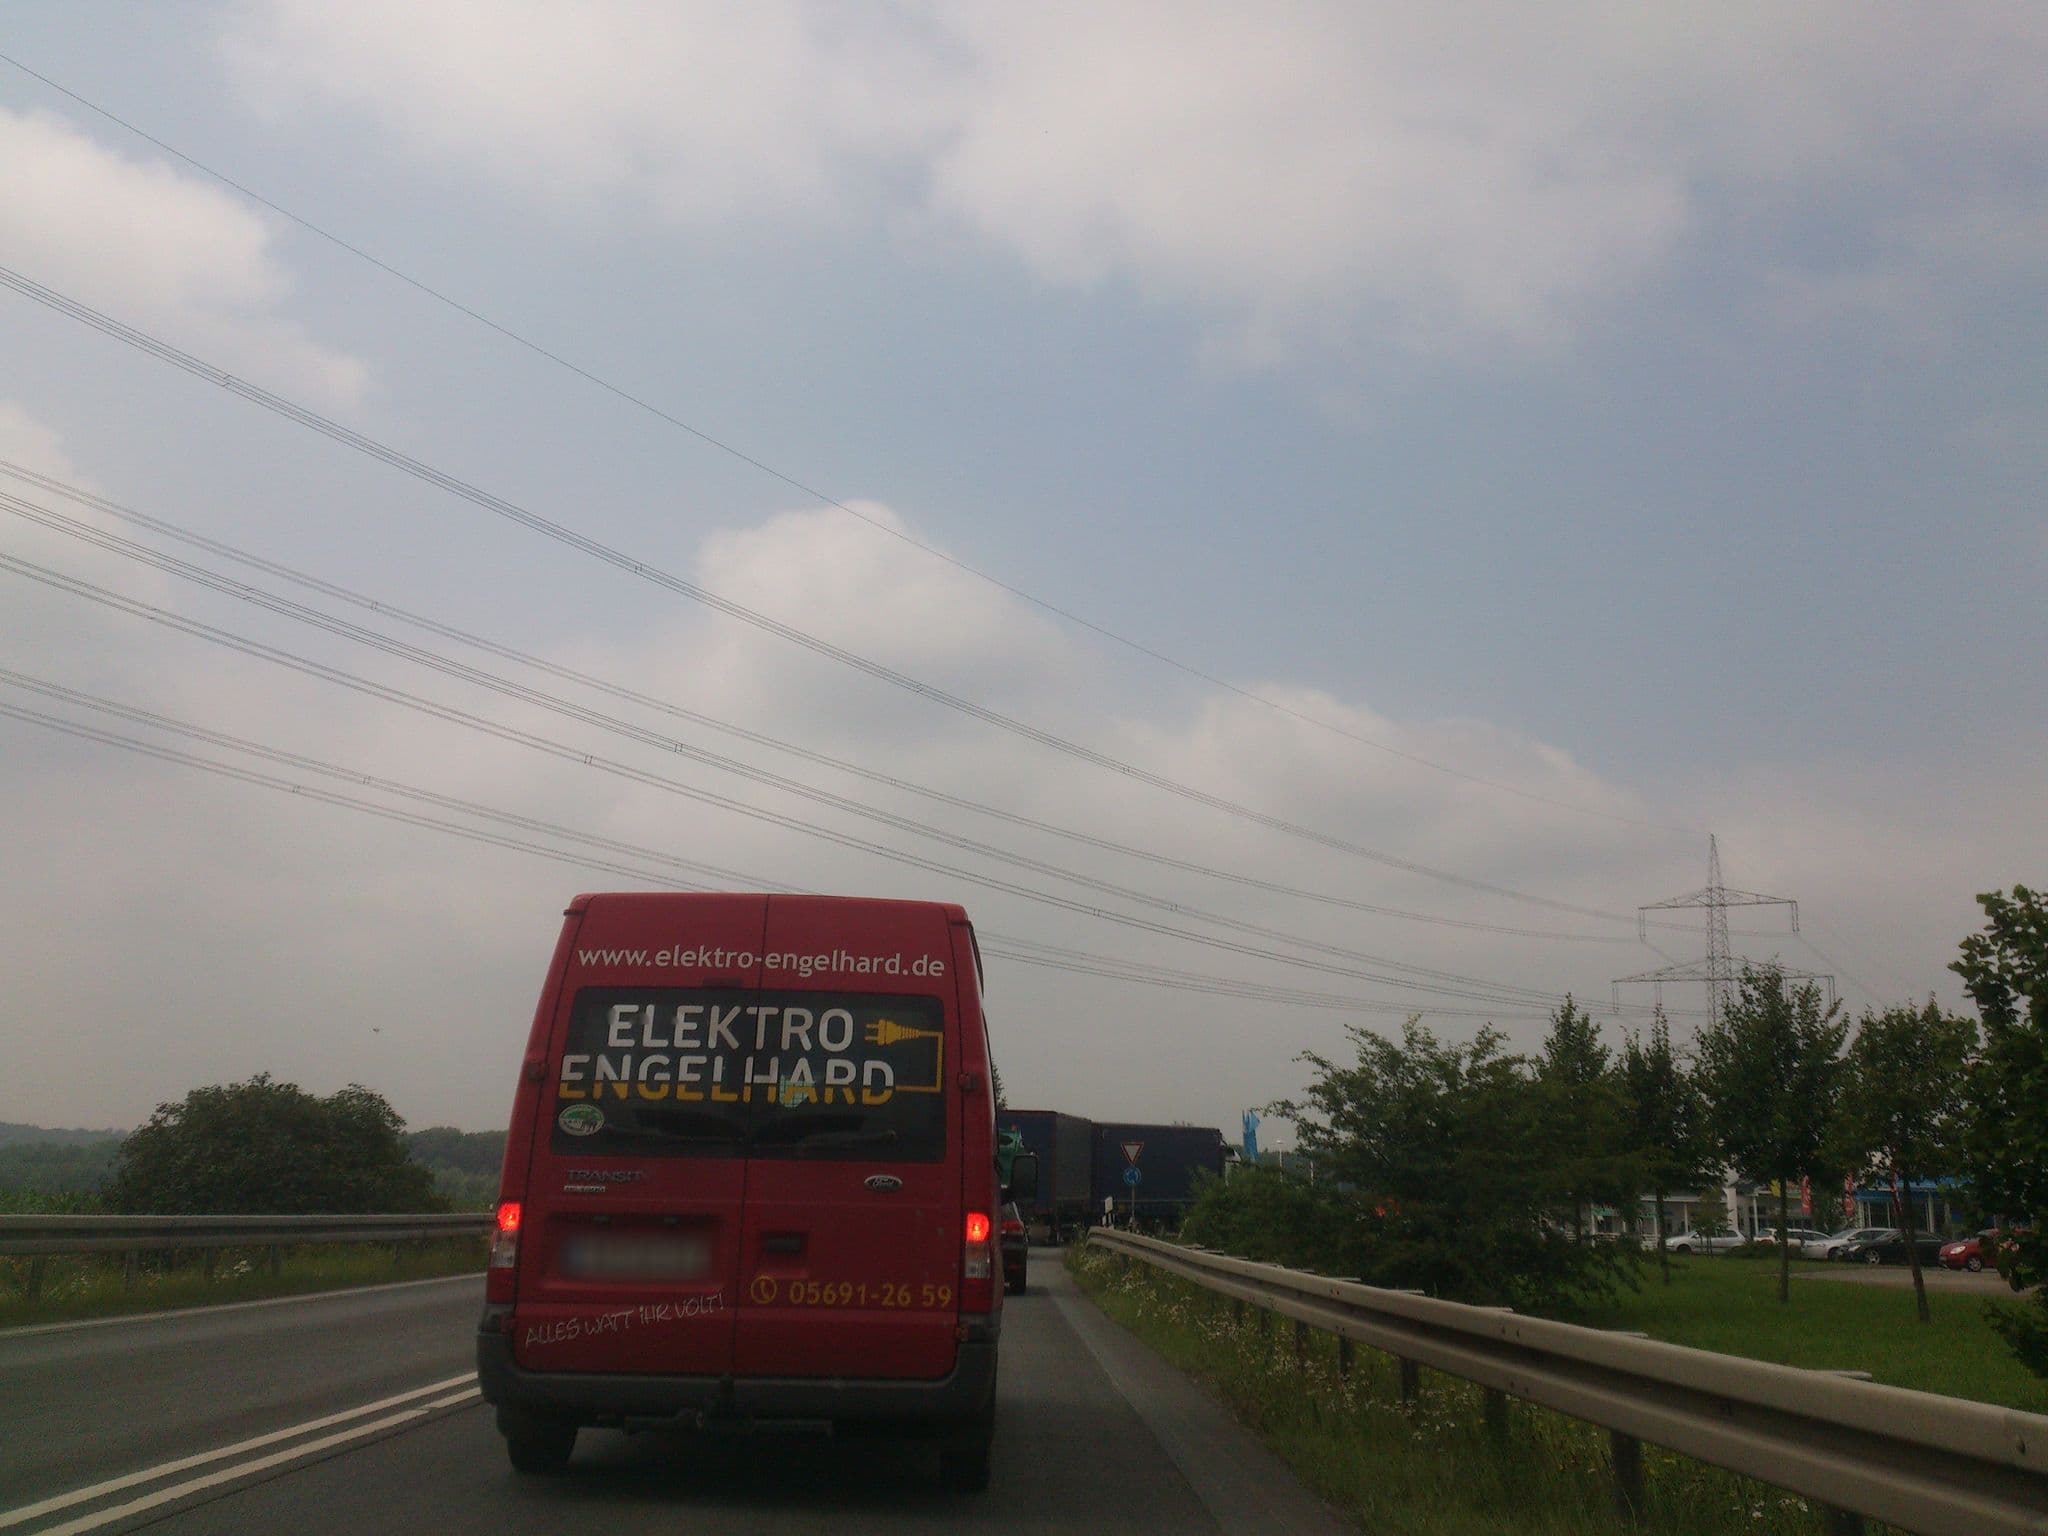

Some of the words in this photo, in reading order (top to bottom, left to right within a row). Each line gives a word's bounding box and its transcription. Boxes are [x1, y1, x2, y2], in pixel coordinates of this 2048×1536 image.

[578, 944, 946, 977] www.elektro-engelhard.de
[606, 1003, 854, 1052] ELEKTRO
[558, 1054, 895, 1106] ENGELHARD
[789, 1281, 912, 1305] 05691-26
[921, 1284, 953, 1308] 59
[525, 1317, 580, 1348] ALLES
[584, 1310, 635, 1335] WATT
[675, 1292, 726, 1318] VOLT!
